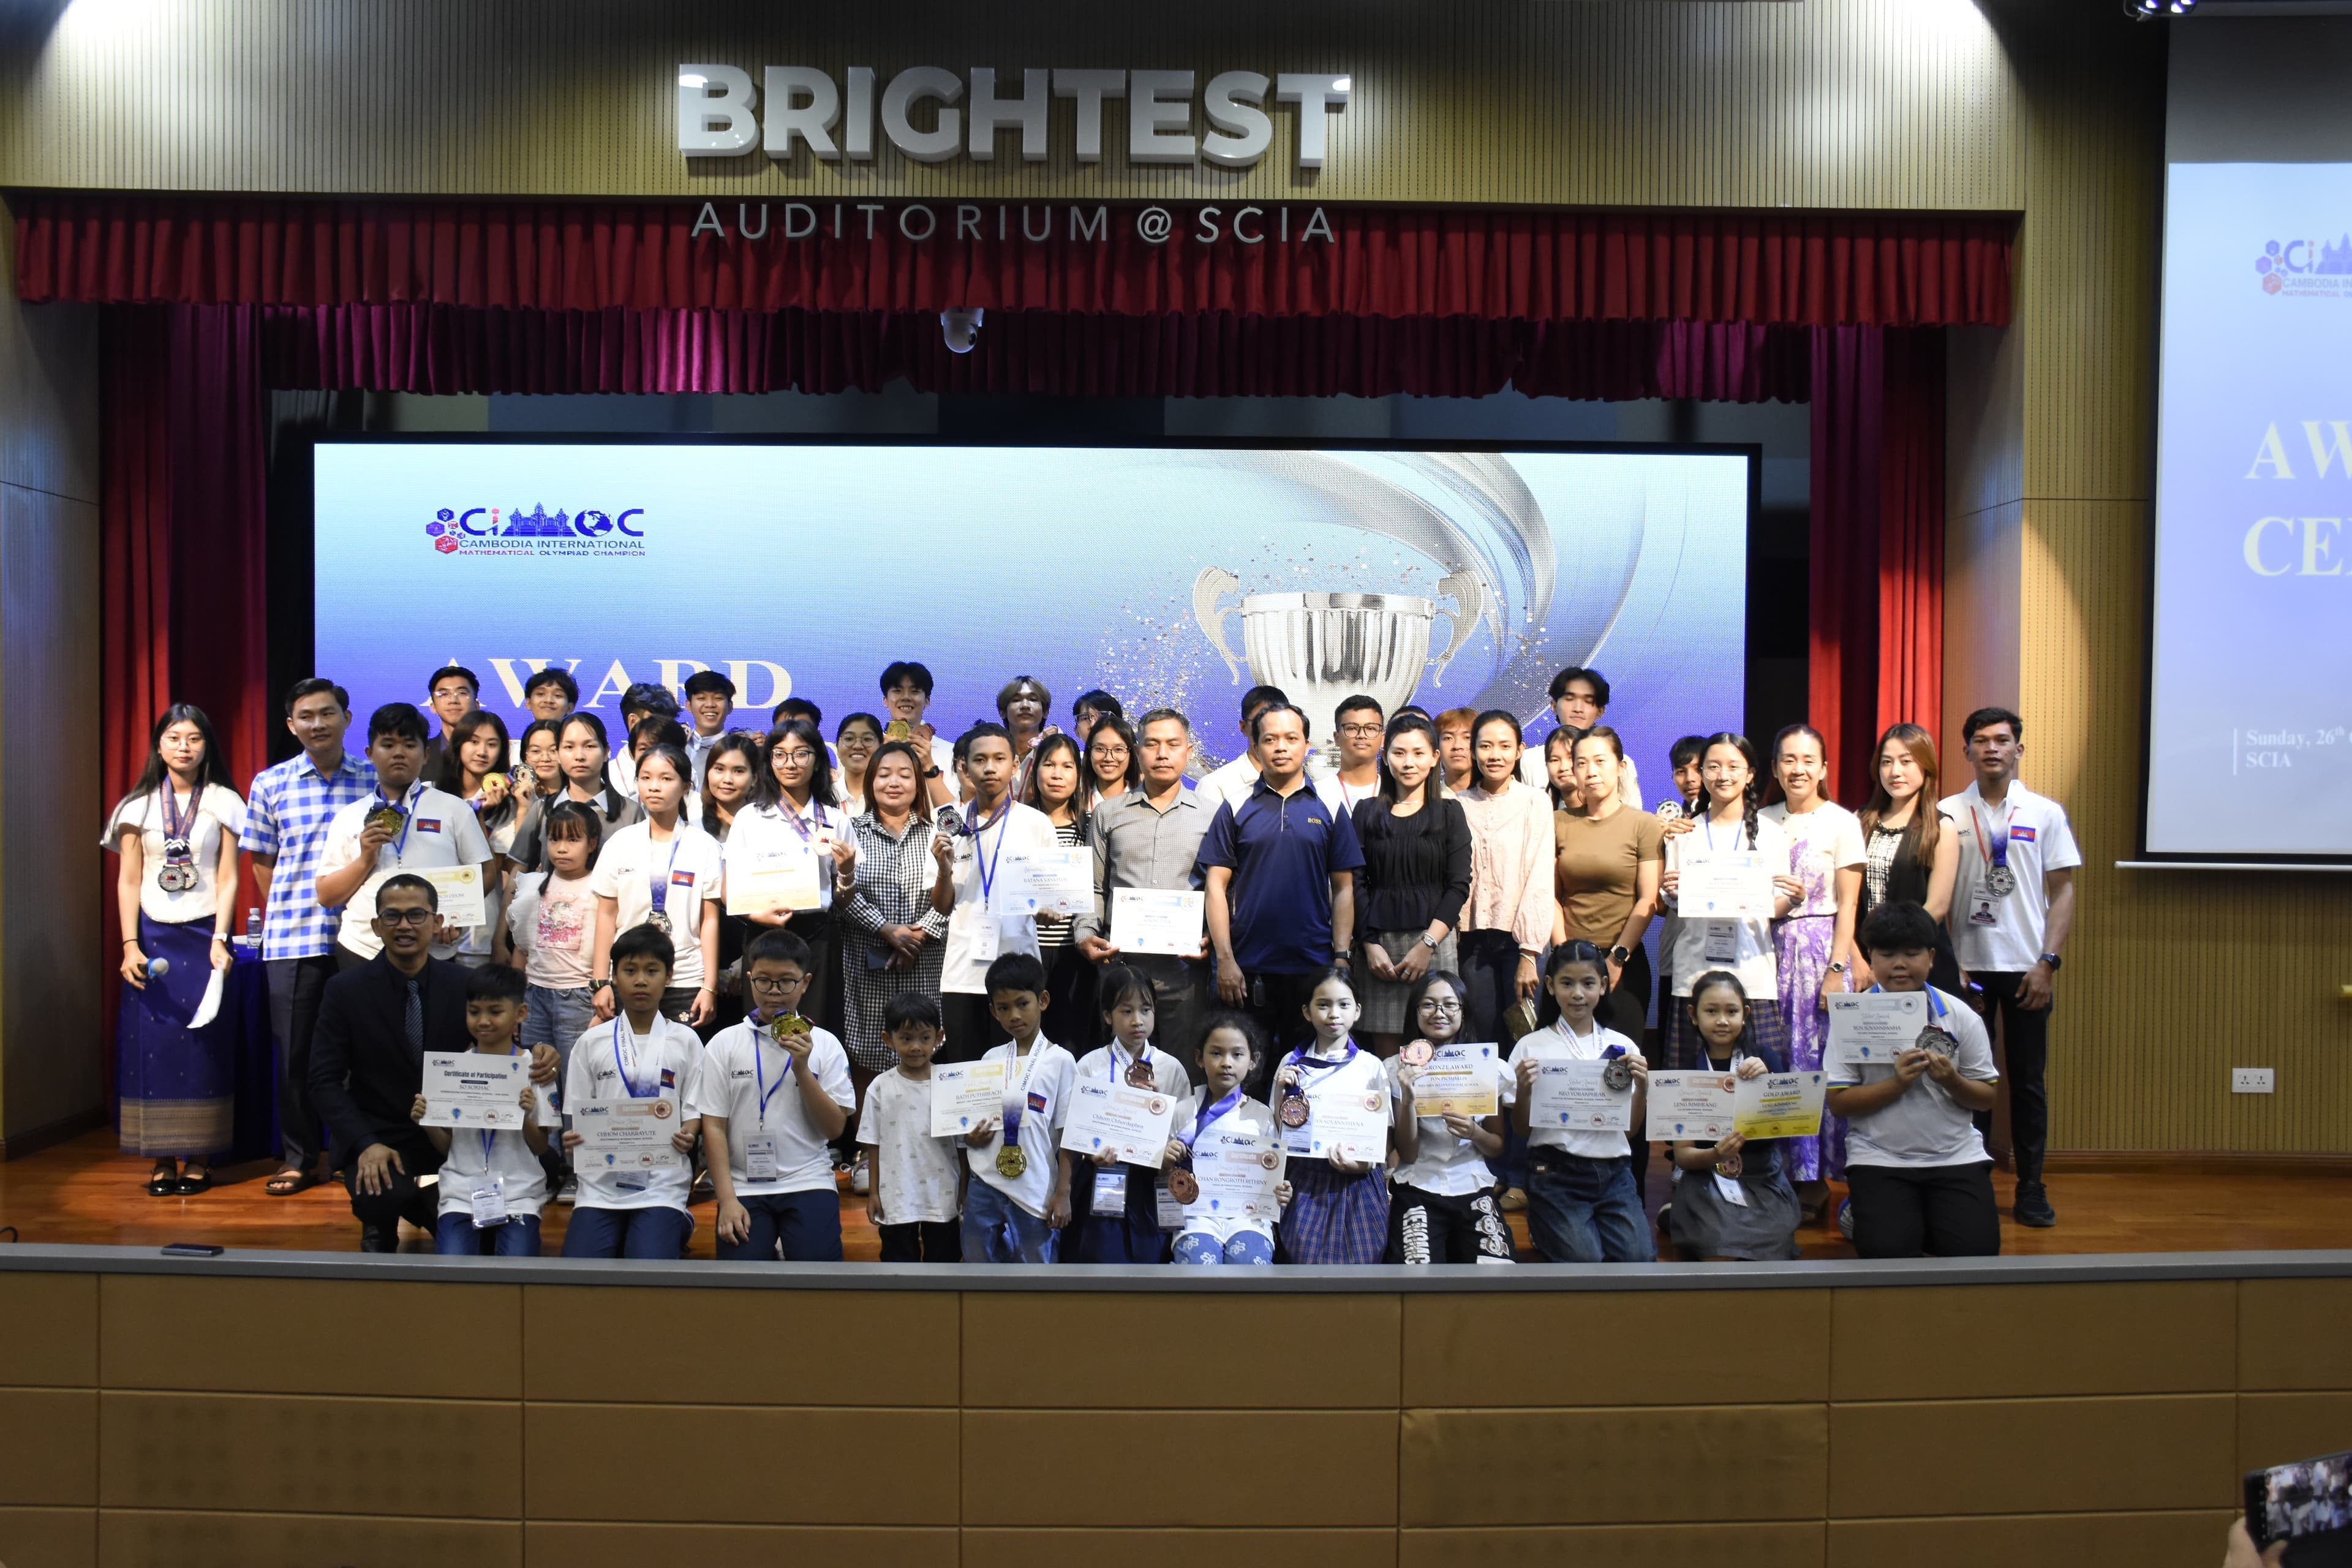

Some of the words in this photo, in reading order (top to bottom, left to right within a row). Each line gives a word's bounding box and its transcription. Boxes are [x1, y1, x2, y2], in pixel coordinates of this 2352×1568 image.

[679, 63, 1351, 168] BRIGHTEST
[691, 202, 1108, 242] AUDITORIUM
[1137, 206, 1172, 244] @
[1195, 206, 1335, 244] SCIA
[2283, 278, 2339, 288] CAMBODIA
[459, 540, 533, 549] CAMBODIA
[537, 540, 645, 549] INTERNATIONAL
[2243, 516, 2352, 577] CE
[2246, 729, 2311, 750] Sunday,
[2246, 752, 2292, 767] SCIA
[476, 1072, 508, 1080] Participation
